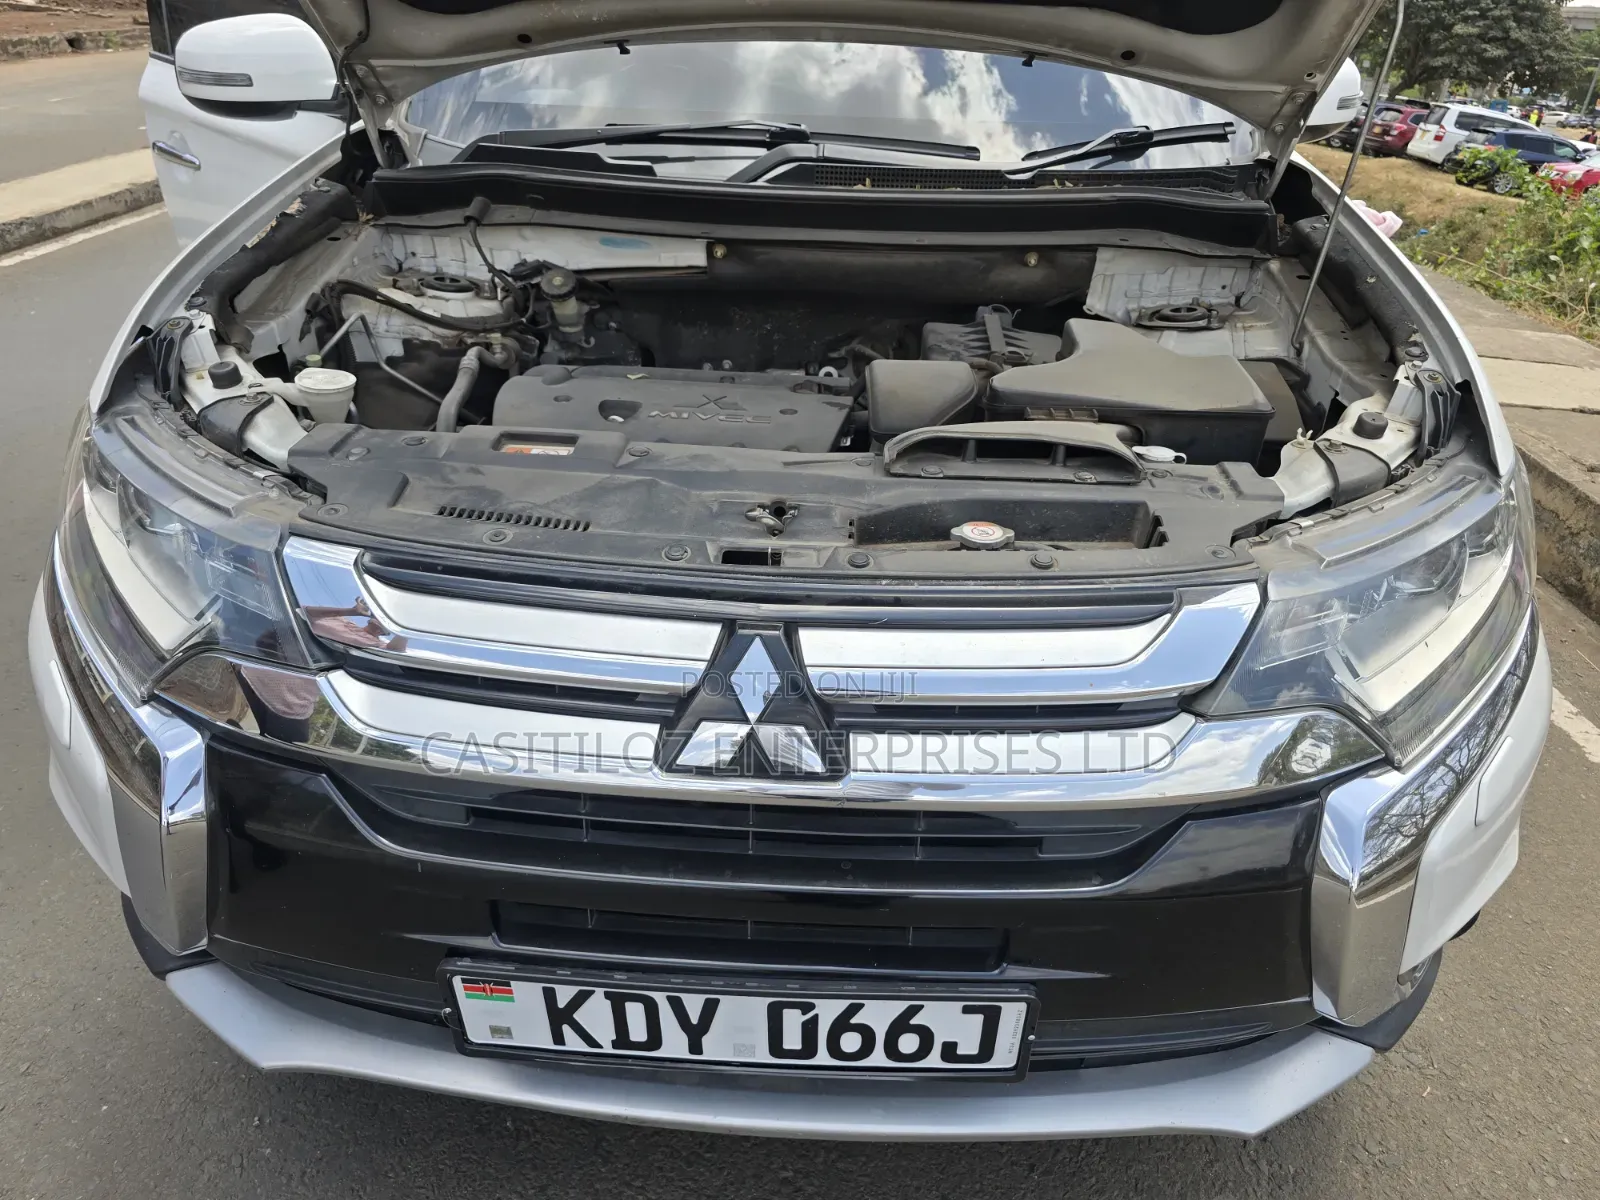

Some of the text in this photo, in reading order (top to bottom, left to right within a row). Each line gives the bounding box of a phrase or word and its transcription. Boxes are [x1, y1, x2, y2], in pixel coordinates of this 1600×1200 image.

[647, 410, 772, 424] MIVEC
[543, 986, 721, 1055] KDY
[766, 1000, 1002, 1064] 066J
